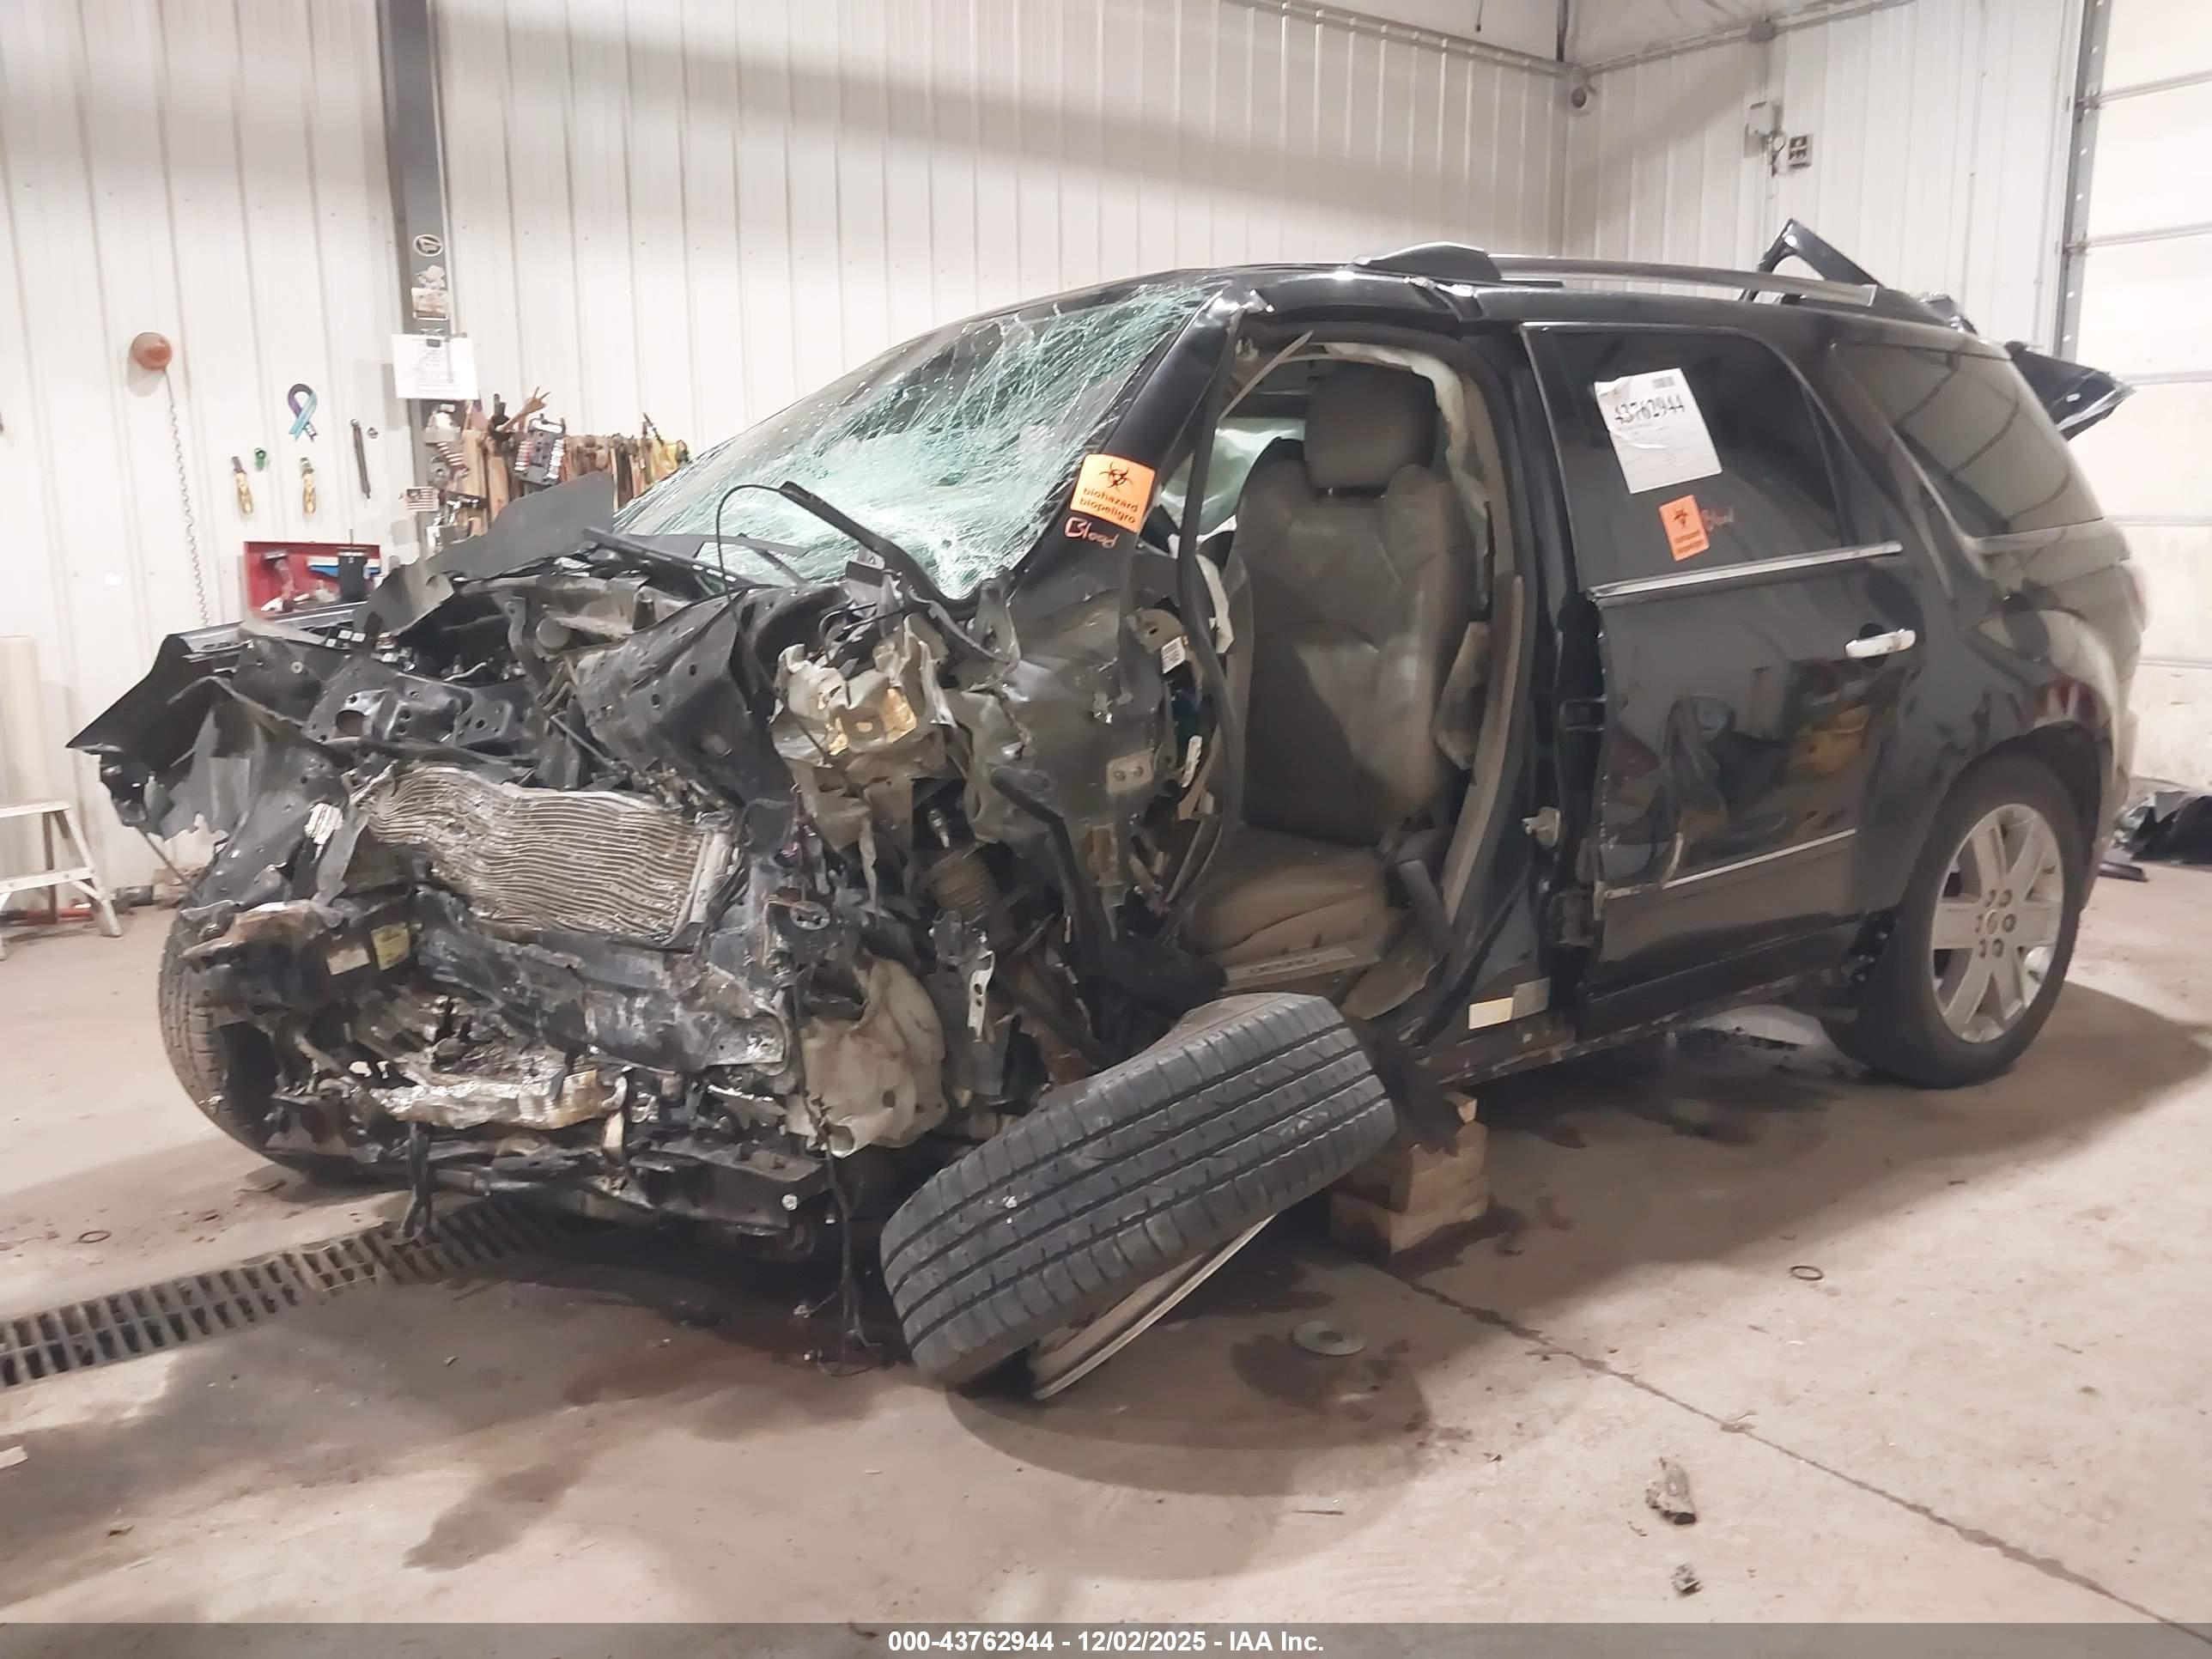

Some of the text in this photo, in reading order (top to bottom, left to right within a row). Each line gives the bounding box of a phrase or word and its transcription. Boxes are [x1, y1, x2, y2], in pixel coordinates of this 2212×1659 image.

[1079, 497, 1136, 524] biopeligro
[1083, 487, 1139, 514] biohazard
[1065, 517, 1120, 550] Blood
